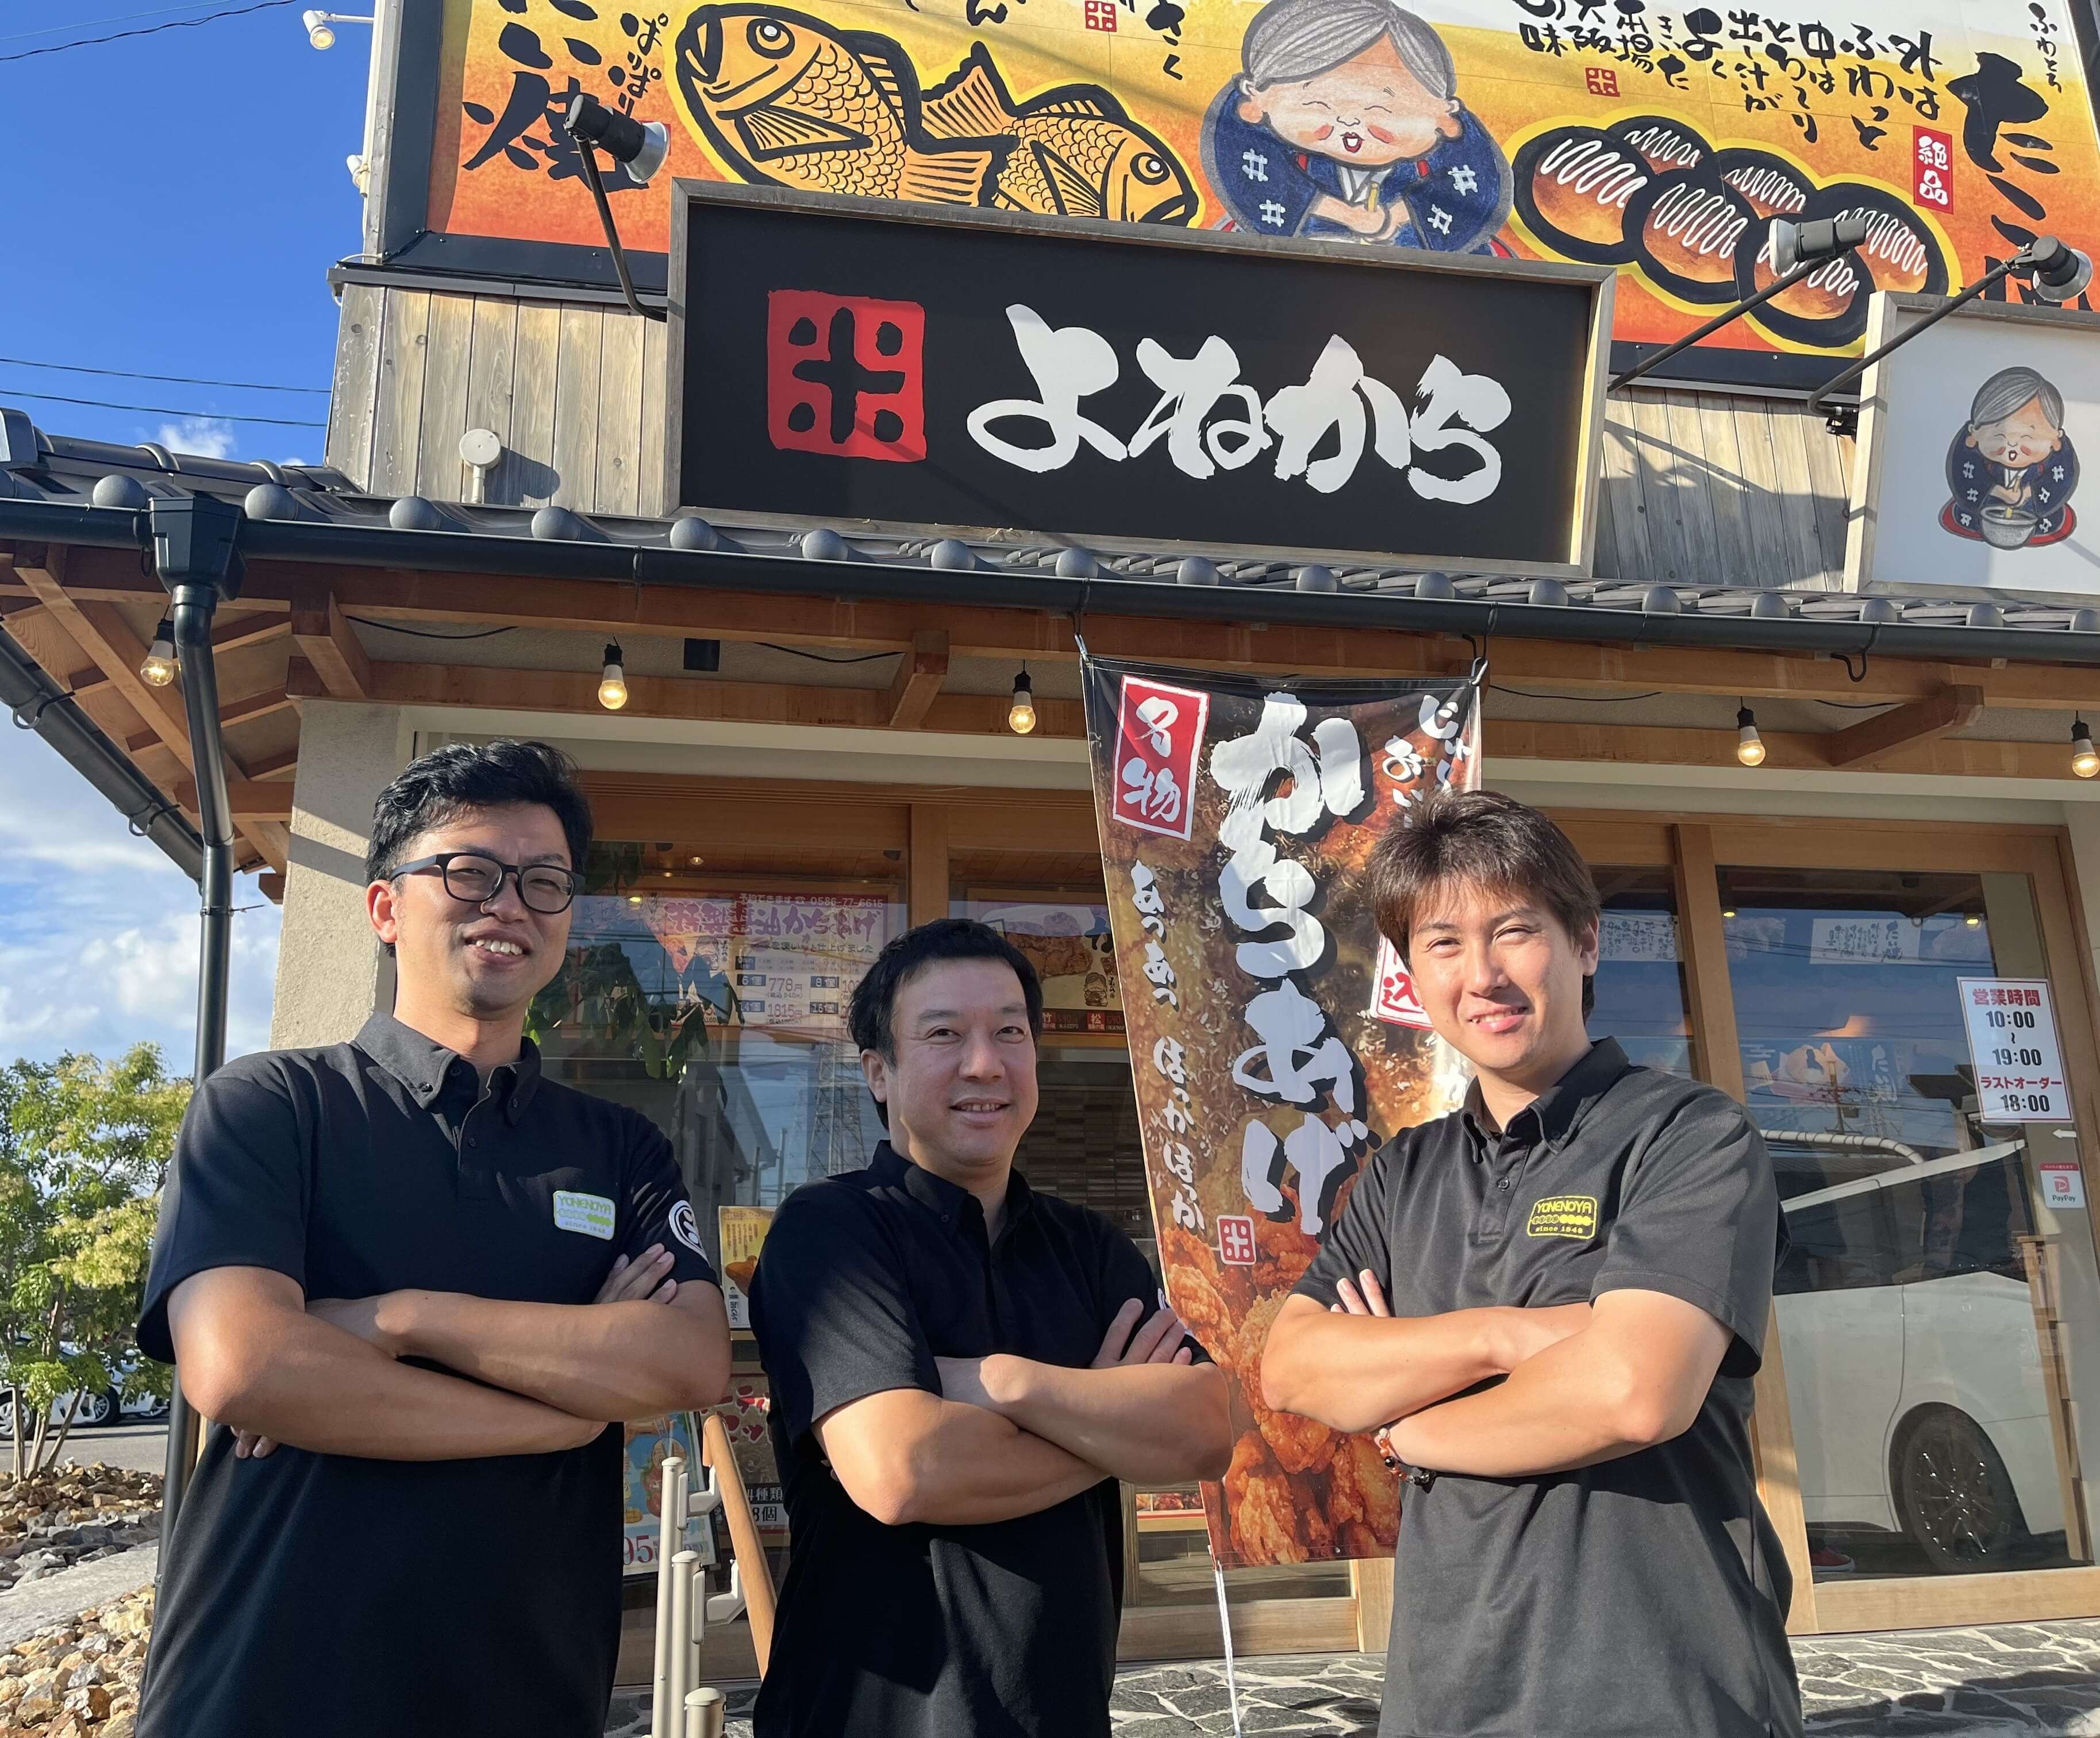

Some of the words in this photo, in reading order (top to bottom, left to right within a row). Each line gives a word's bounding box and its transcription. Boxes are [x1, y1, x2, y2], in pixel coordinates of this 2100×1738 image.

[1917, 135, 1950, 206] 絶品
[967, 303, 1513, 505] よねから
[1209, 691, 1369, 1235] からあげ
[1972, 989, 2041, 1007] 営業時間
[1986, 1010, 2035, 1029] 10:00
[1992, 1048, 2042, 1066] 19:00
[1980, 1076, 2063, 1090] ラストオーダー
[2001, 1094, 2050, 1112] 18:00
[1537, 1199, 1592, 1214] YONENOYA
[2052, 1194, 2076, 1202] PayPay
